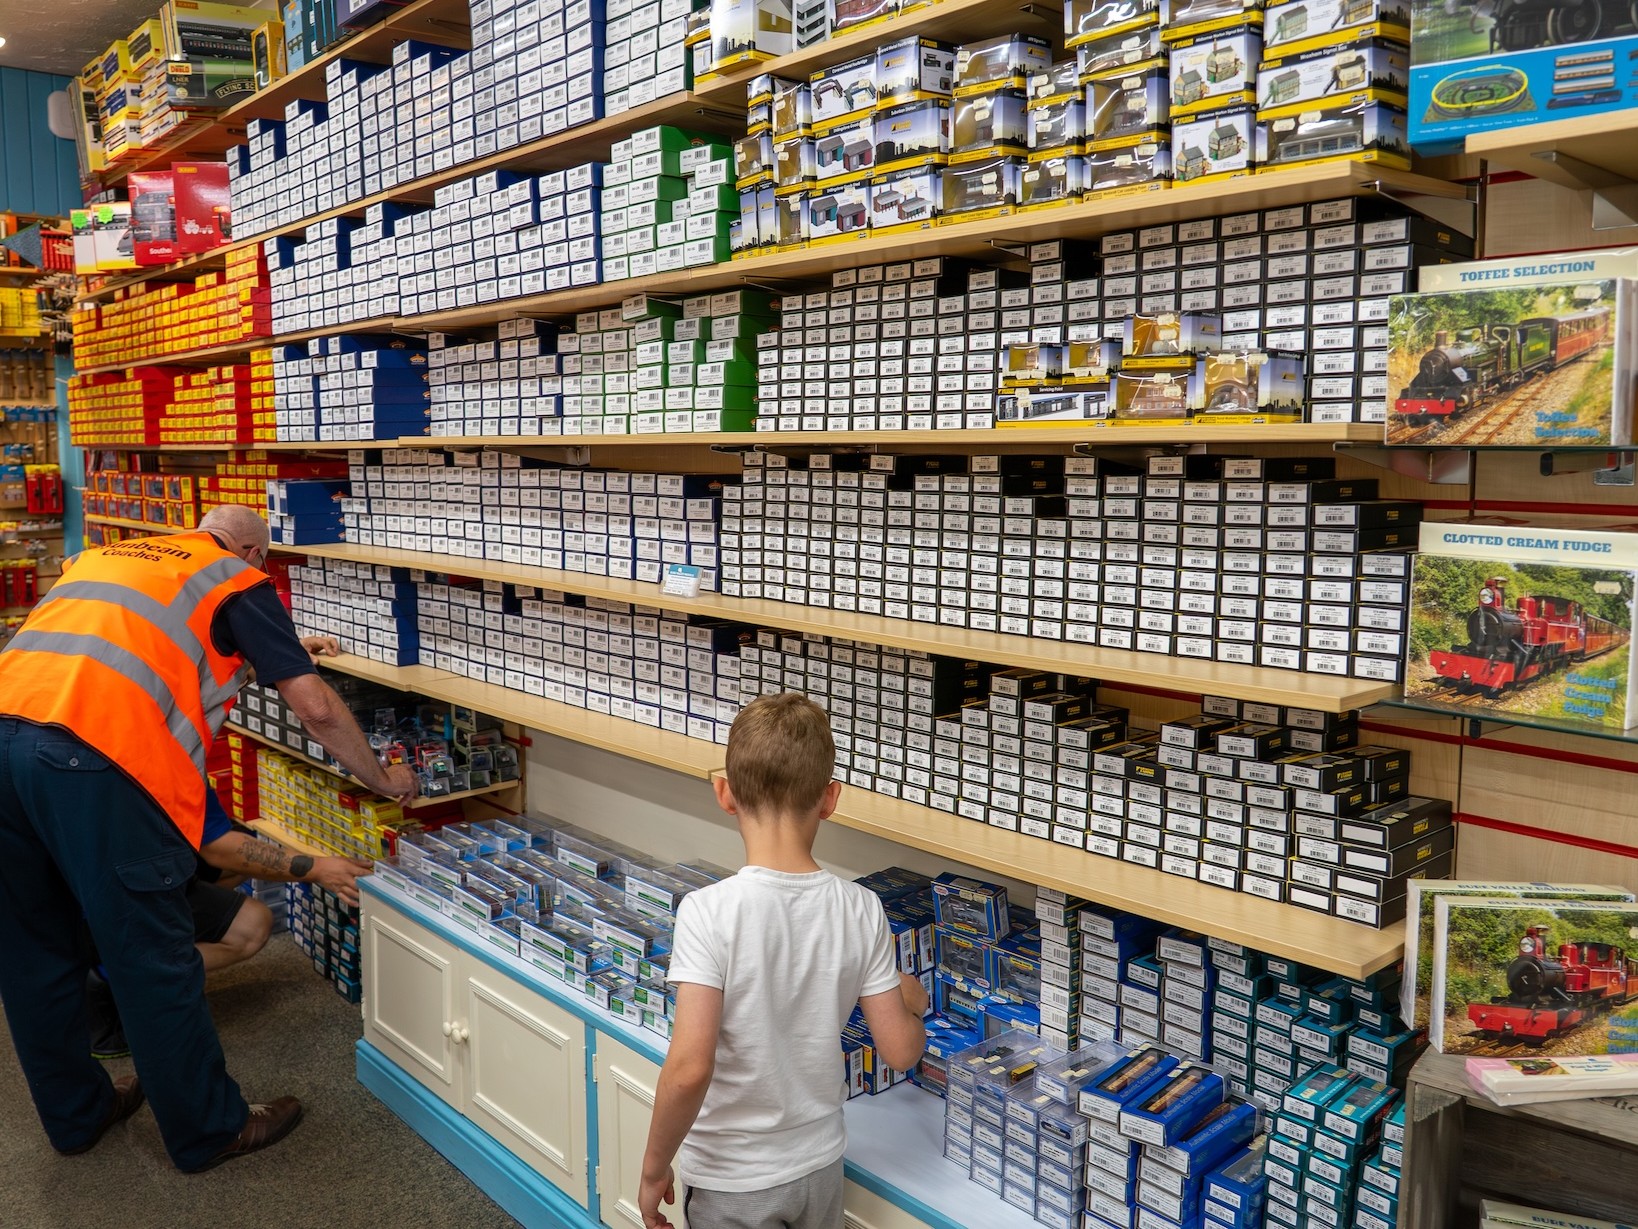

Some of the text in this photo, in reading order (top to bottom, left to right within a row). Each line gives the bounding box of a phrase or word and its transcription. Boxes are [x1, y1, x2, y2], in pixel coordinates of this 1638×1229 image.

[219, 84, 242, 96] FLYING
[1460, 260, 1596, 282] TOFFEE SELECTION
[1536, 411, 1577, 422] Toffee
[1536, 426, 1600, 438] Selection
[1443, 533, 1612, 553] CLOTTED CREAM FUDGE
[102, 549, 163, 562] Coaches
[1566, 673, 1616, 688] Clotted
[1564, 688, 1611, 703] Cream
[1564, 702, 1605, 718] Fudge
[1140, 1075, 1151, 1085] Scale
[1148, 1066, 1162, 1077] Model
[1180, 1094, 1194, 1104] Scale
[1191, 1085, 1206, 1096] Model
[1209, 1123, 1223, 1133] Scale
[1221, 1114, 1237, 1125] Model
[1532, 1216, 1566, 1226] BURE
